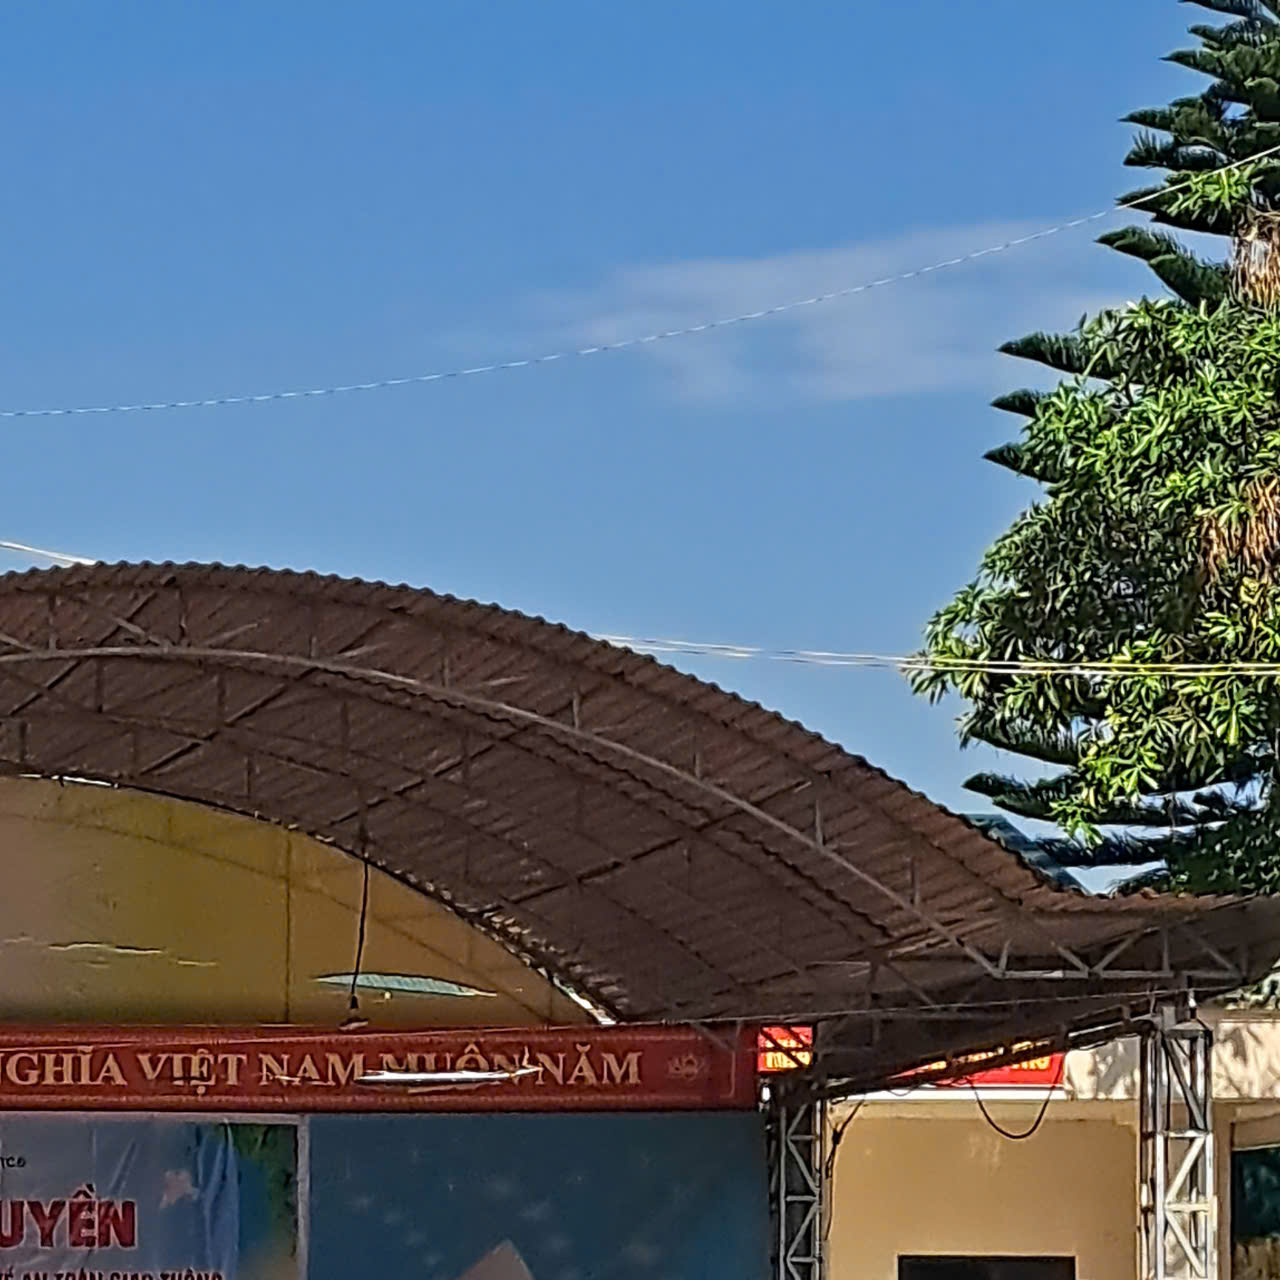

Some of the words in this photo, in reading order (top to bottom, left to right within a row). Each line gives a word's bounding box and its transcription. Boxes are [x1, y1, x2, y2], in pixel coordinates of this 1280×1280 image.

[137, 1049, 248, 1095] VIỆT
[259, 1052, 367, 1086] NAM
[535, 1043, 643, 1086] NĂM
